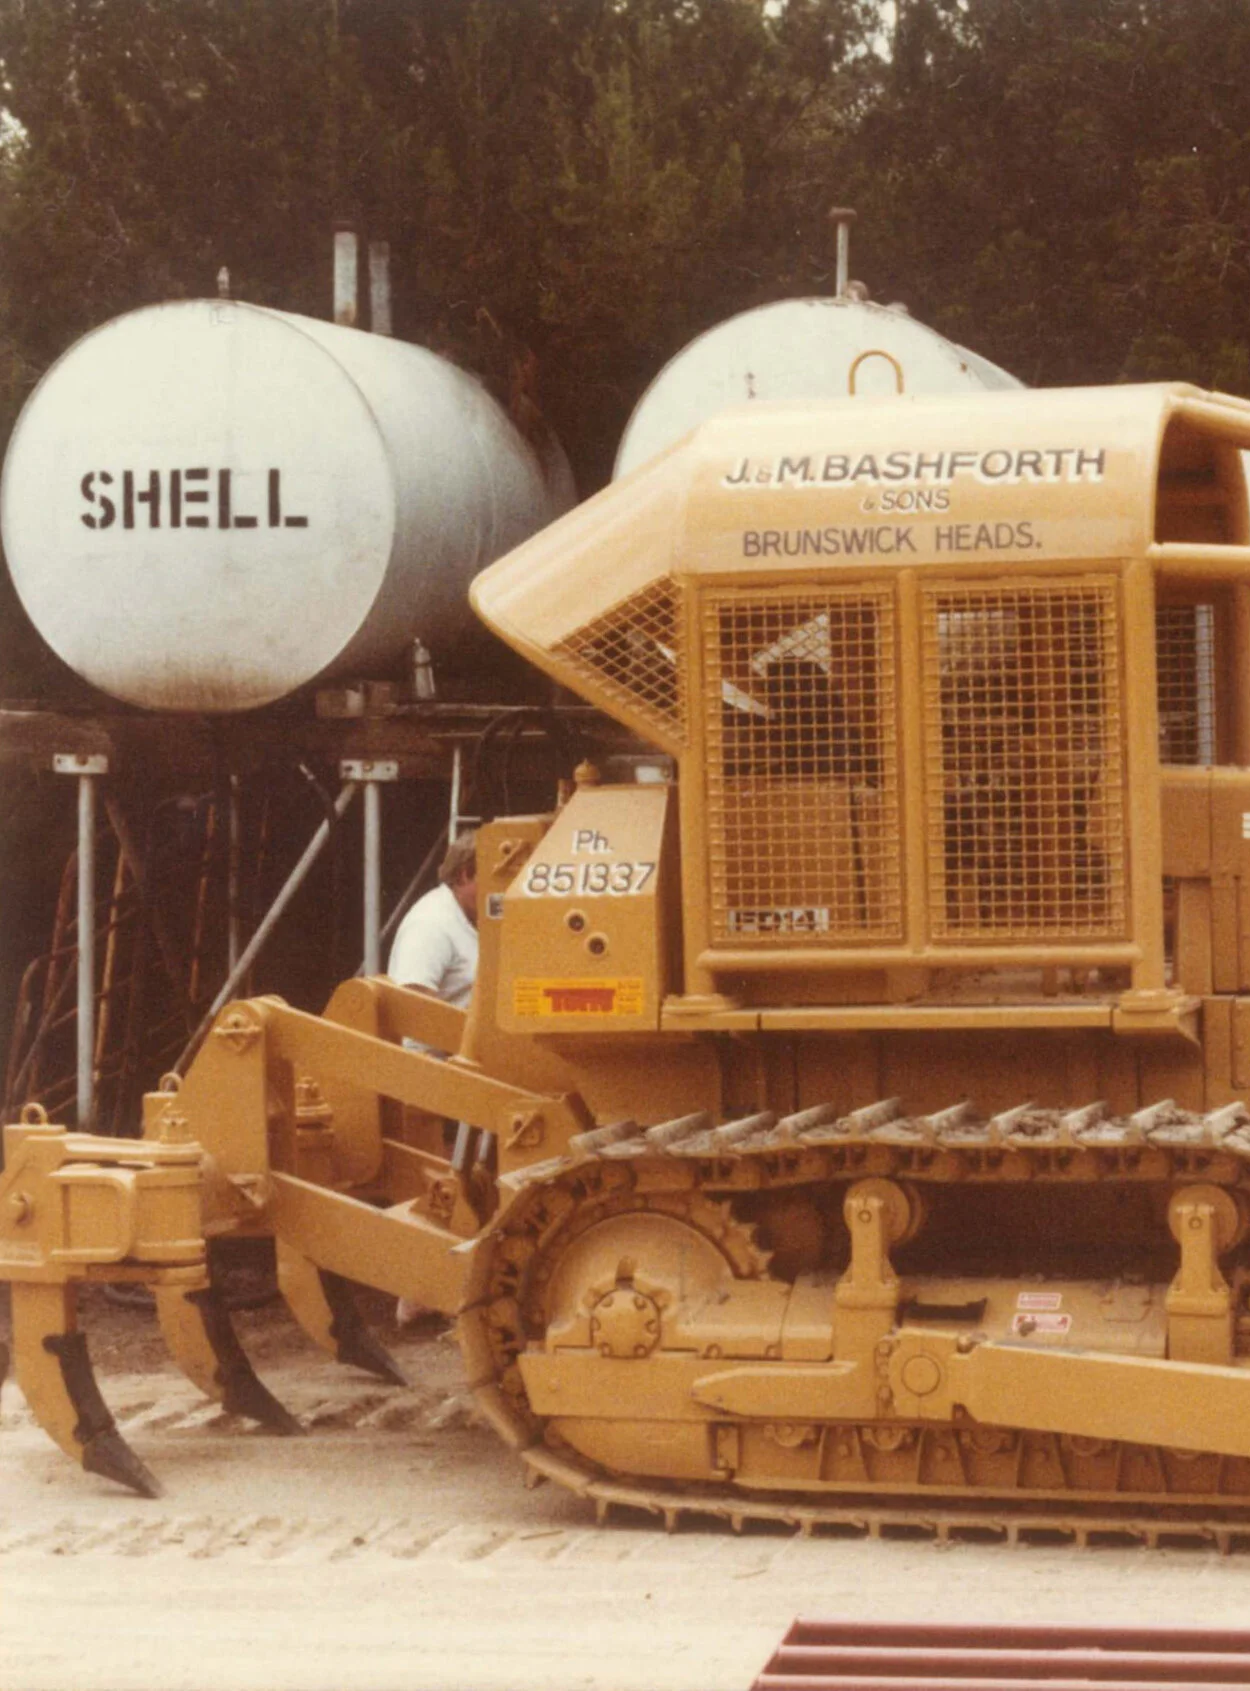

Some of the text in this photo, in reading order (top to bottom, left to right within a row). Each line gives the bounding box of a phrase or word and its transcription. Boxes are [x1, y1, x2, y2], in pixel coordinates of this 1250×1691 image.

[80, 468, 308, 530] SHELL
[880, 489, 950, 511] SONS
[742, 521, 1043, 557] BRUNSWICK HEADS.
